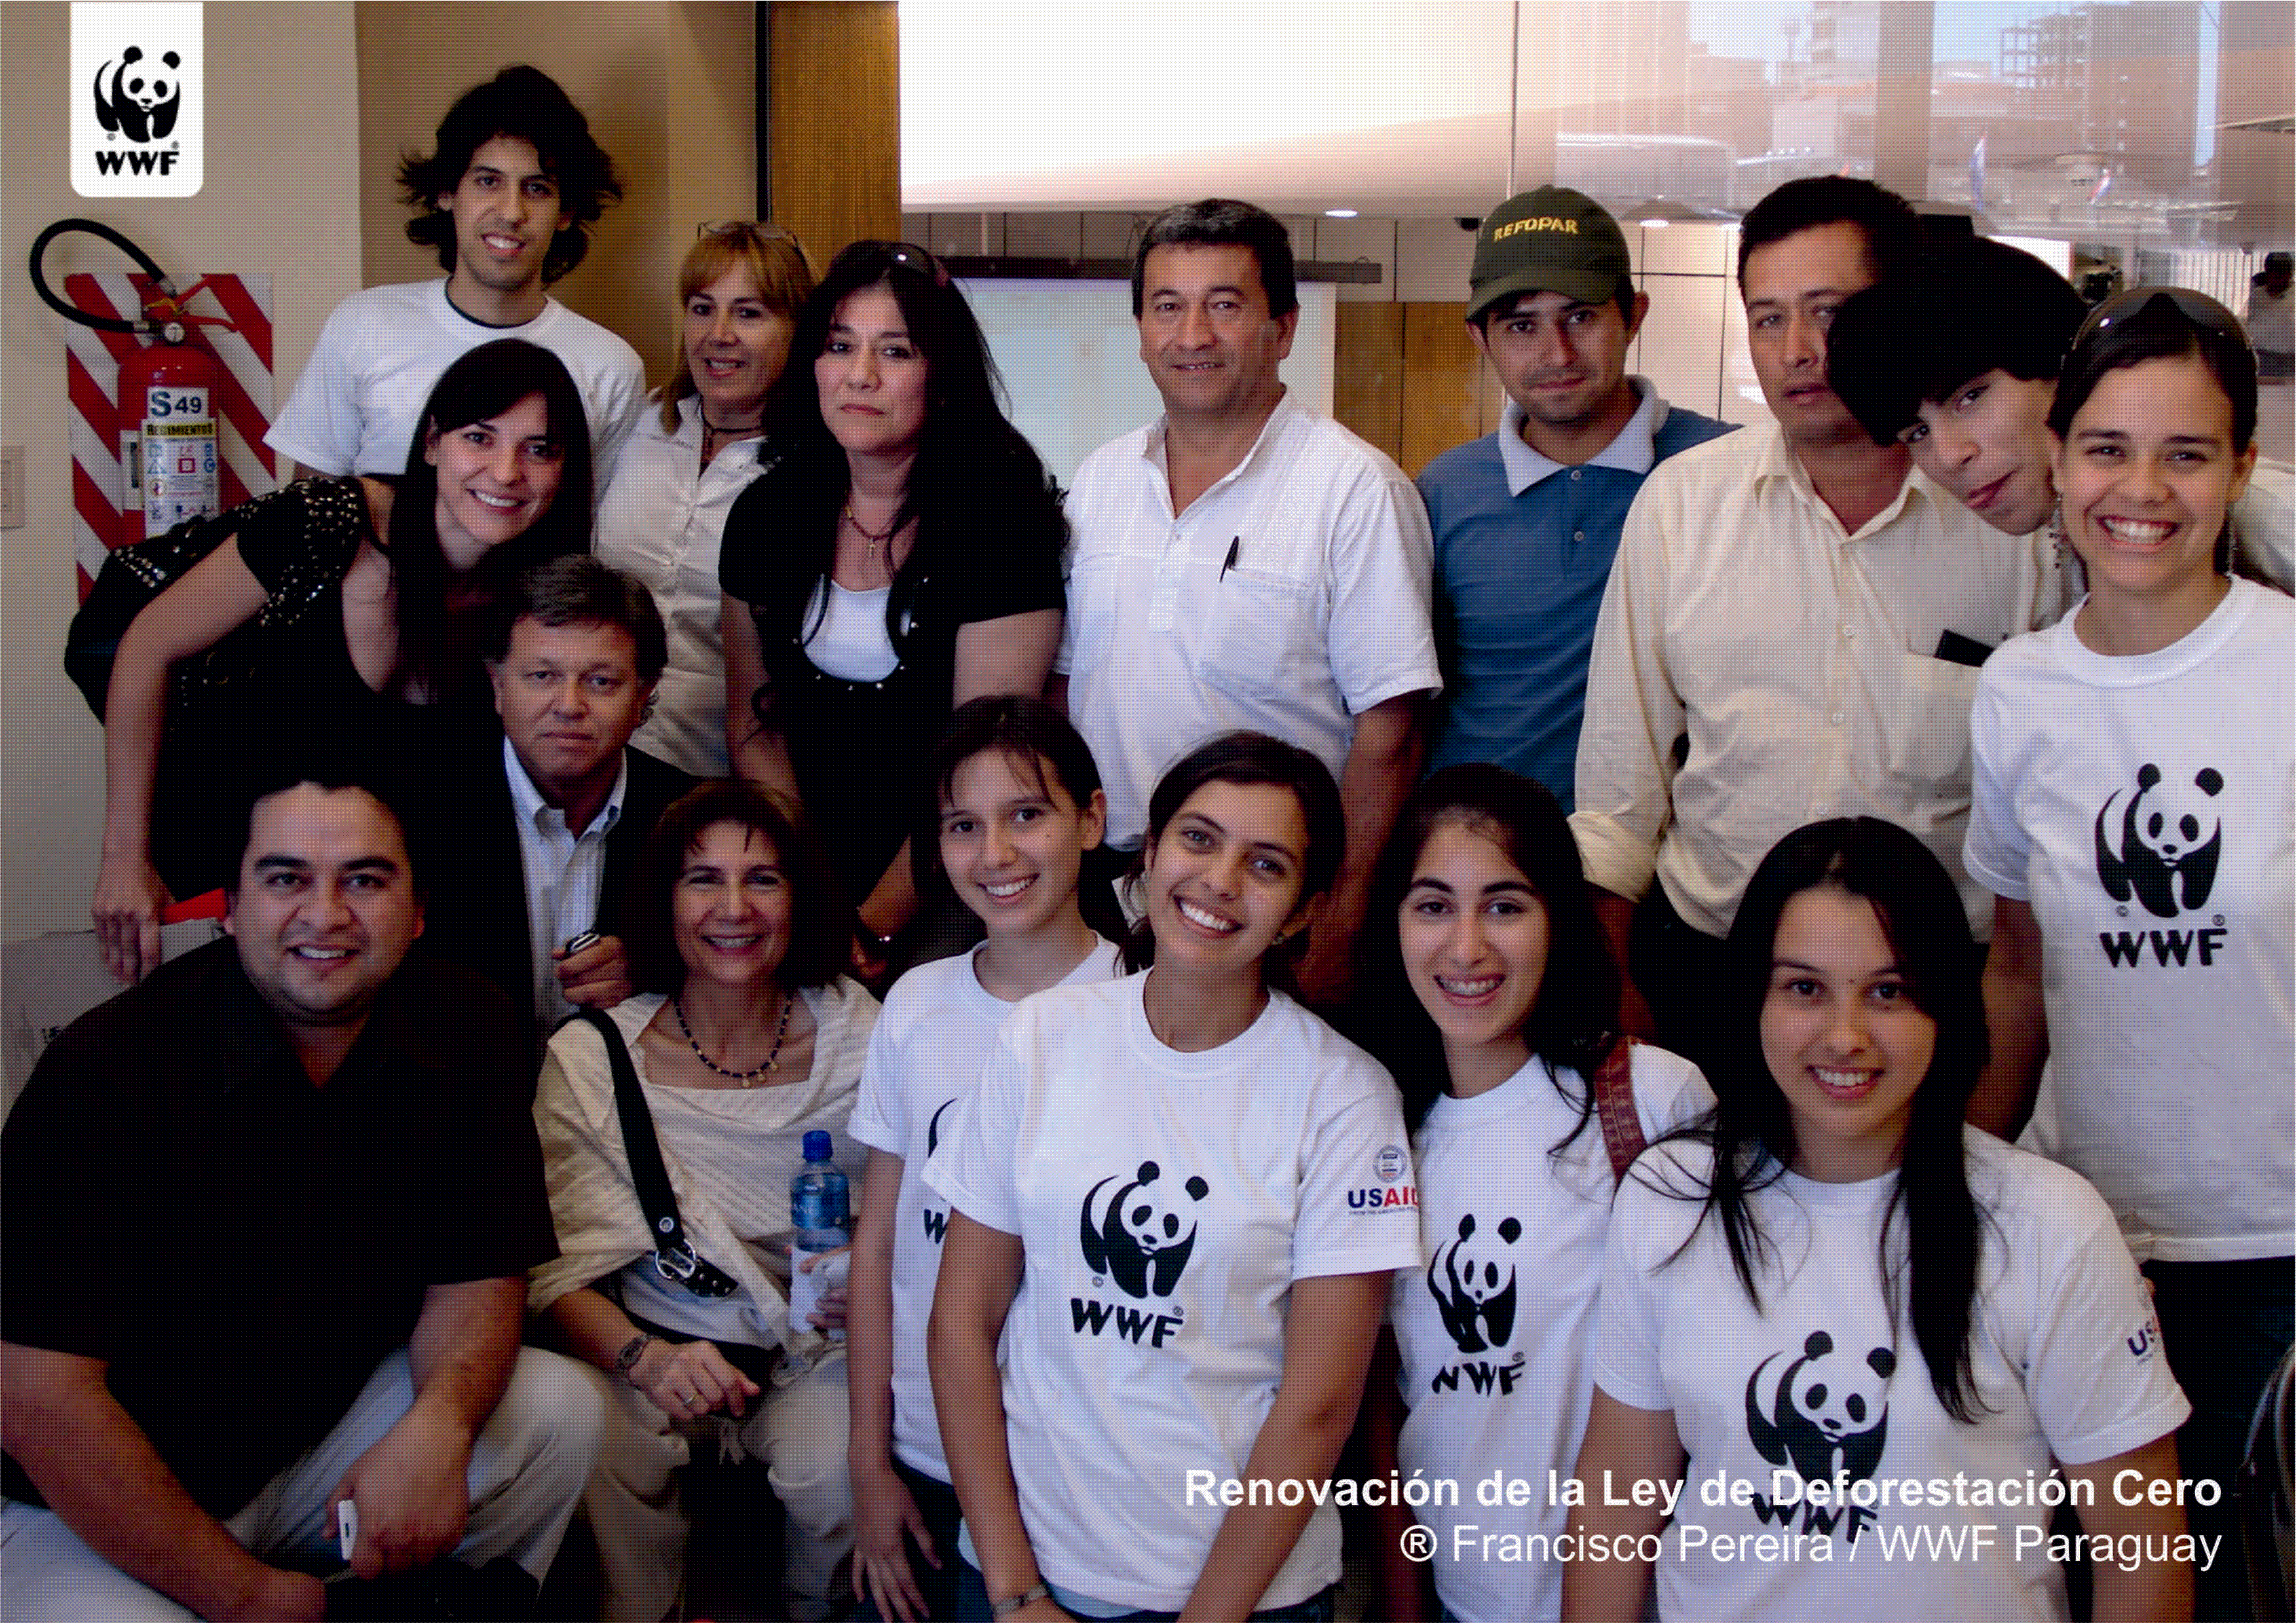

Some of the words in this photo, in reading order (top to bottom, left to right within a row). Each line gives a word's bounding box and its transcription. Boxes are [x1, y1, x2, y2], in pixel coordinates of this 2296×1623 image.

[1493, 217, 1579, 242] REFOPAR
[150, 391, 172, 417] S
[174, 396, 202, 413] 49
[2099, 928, 2228, 968] WWF
[1070, 1297, 1184, 1349] WWF
